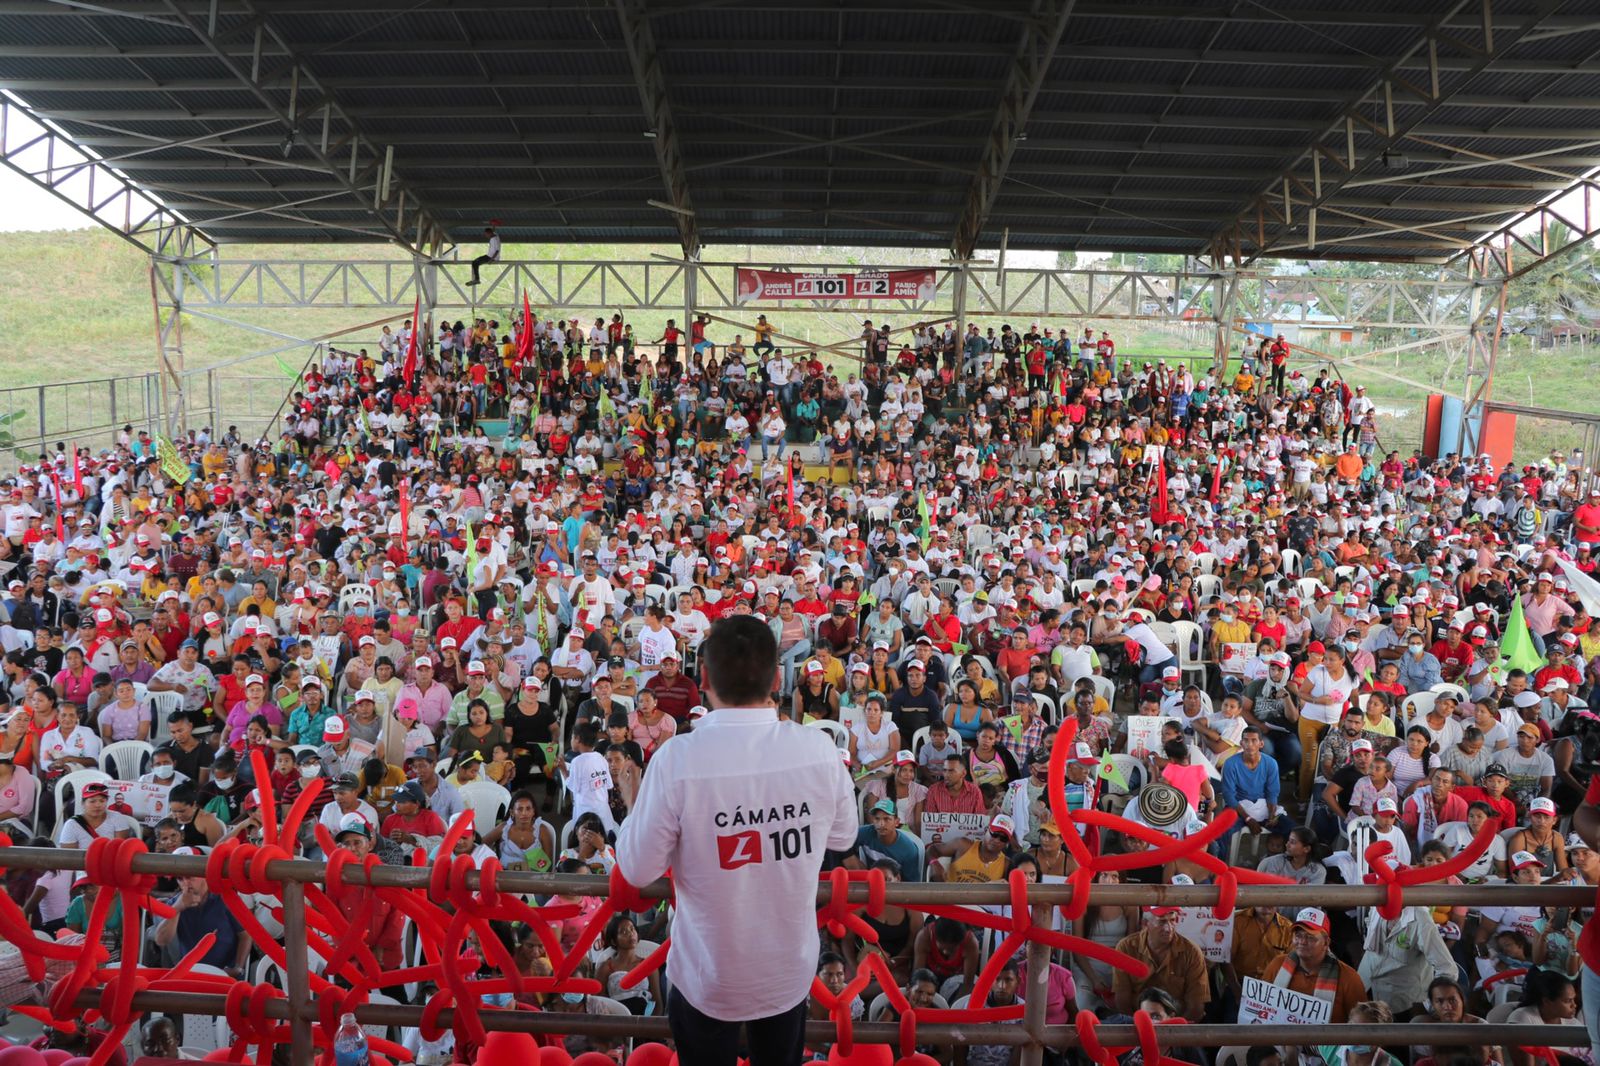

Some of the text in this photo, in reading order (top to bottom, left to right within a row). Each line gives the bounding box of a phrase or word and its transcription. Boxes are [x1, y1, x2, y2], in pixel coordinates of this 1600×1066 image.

[765, 288, 792, 296] CALLE
[816, 280, 844, 294] 101
[875, 280, 887, 294] 2
[714, 802, 811, 828] CÁMARA
[923, 813, 946, 824] QUE
[769, 824, 812, 861] 101
[1246, 979, 1274, 1006] QUE
[1246, 999, 1263, 1010] FABIO
